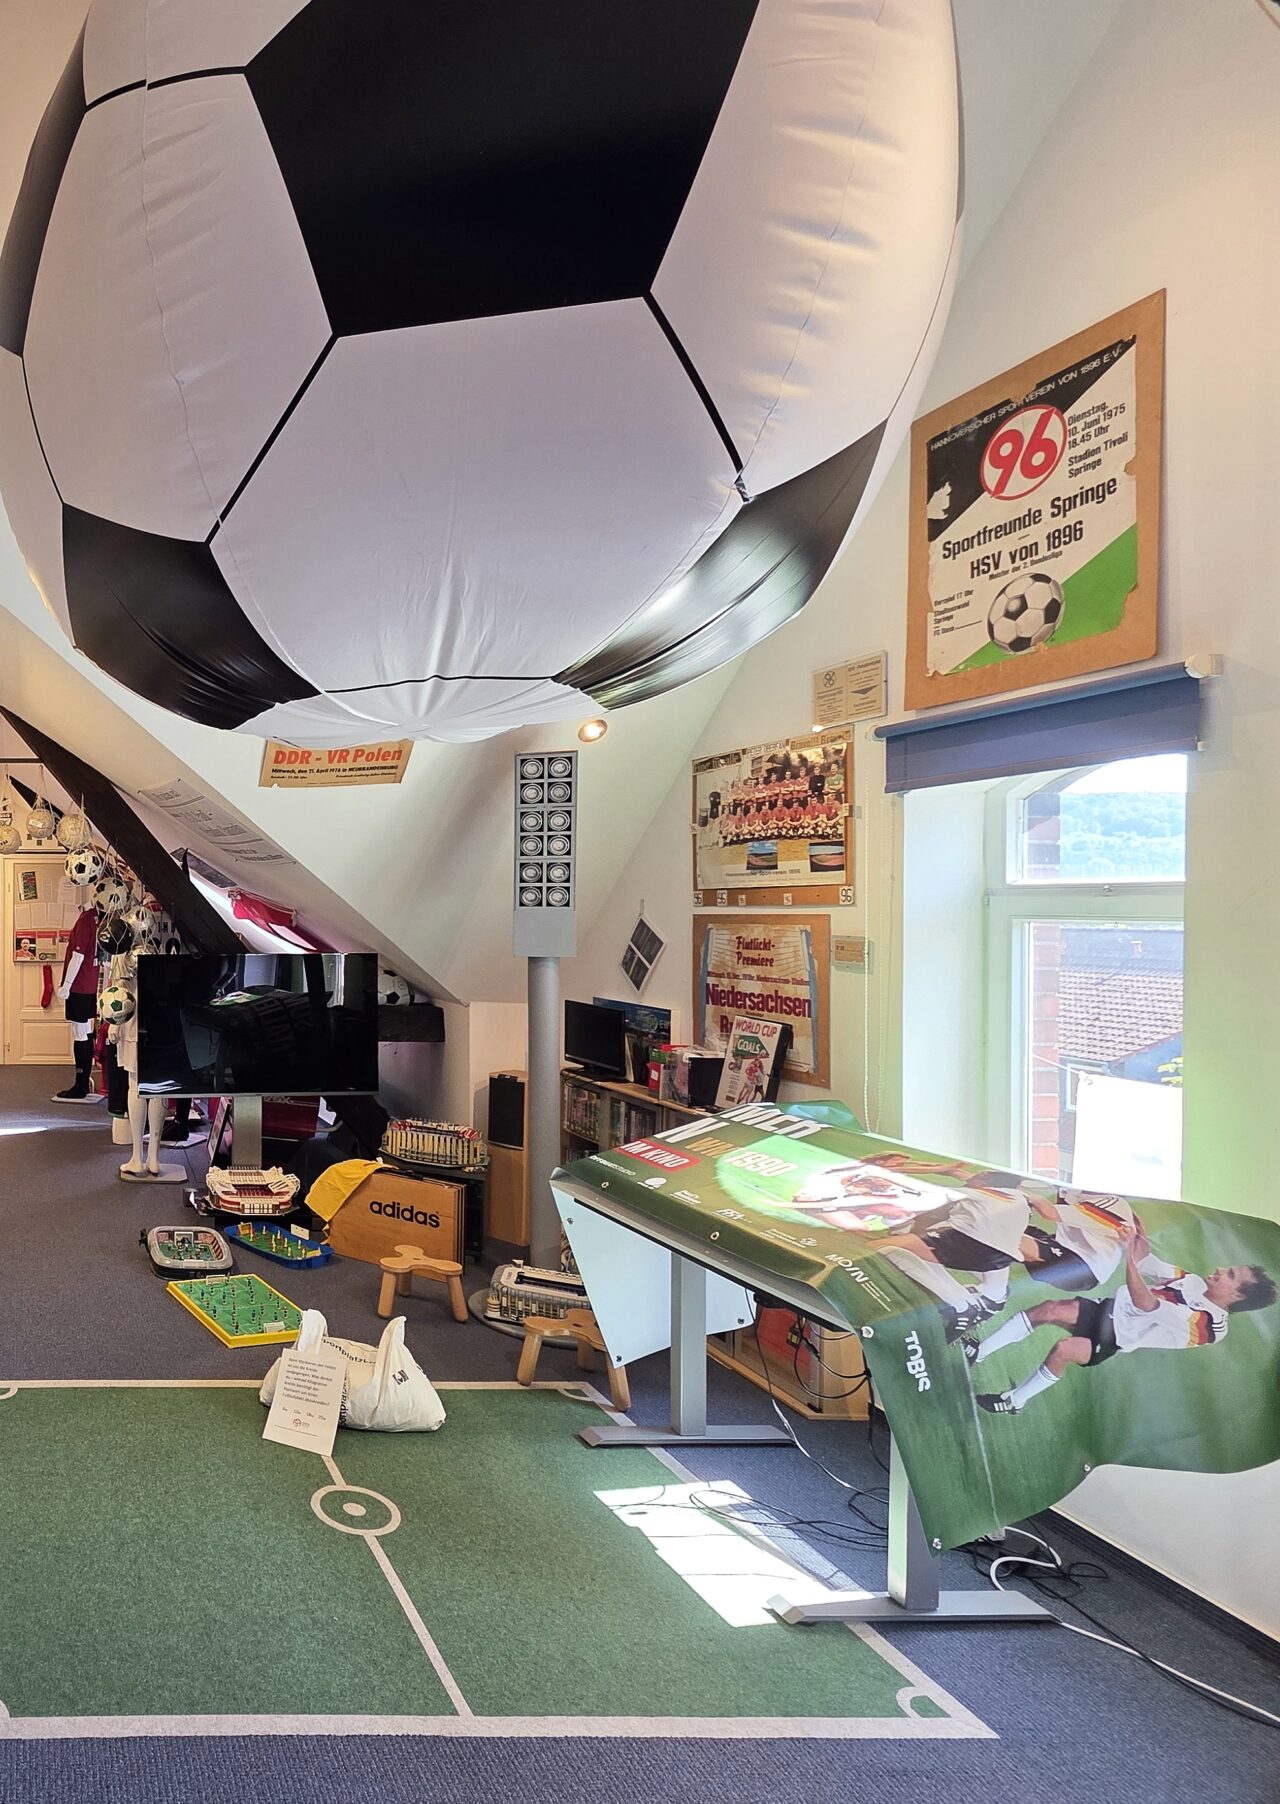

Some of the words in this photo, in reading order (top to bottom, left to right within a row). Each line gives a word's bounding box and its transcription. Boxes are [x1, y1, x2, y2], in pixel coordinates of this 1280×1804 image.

[1057, 370, 1078, 386] VON
[1080, 358, 1101, 375] 1896
[1068, 426, 1080, 438] 10.
[1081, 414, 1101, 431] Juni
[1103, 403, 1126, 421] 1975
[1068, 433, 1092, 450] 18.45
[1093, 424, 1111, 439] Uhr
[1068, 446, 1102, 467] Stadion
[1103, 432, 1129, 451] Tivoli
[989, 407, 1058, 498] 96
[1068, 458, 1102, 478] Springe
[942, 508, 1043, 561] Sportfreunde
[1050, 478, 1118, 519] Springe
[970, 551, 1002, 579] HSV
[1009, 541, 1040, 566] von
[1046, 520, 1084, 551] 1896
[273, 750, 312, 765] DDR
[327, 749, 350, 764] VR
[352, 748, 402, 763] Polen
[736, 952, 775, 968] Premiere
[705, 983, 812, 1018] Niedersachsen
[735, 1018, 760, 1035] WORLD
[761, 1024, 778, 1038] CUP
[737, 1039, 761, 1054] GOALS
[620, 1140, 653, 1155] IM
[640, 1148, 691, 1168] KINO
[724, 1150, 799, 1177] 1990
[370, 1201, 440, 1228] adidas
[824, 1254, 869, 1284] MOIN
